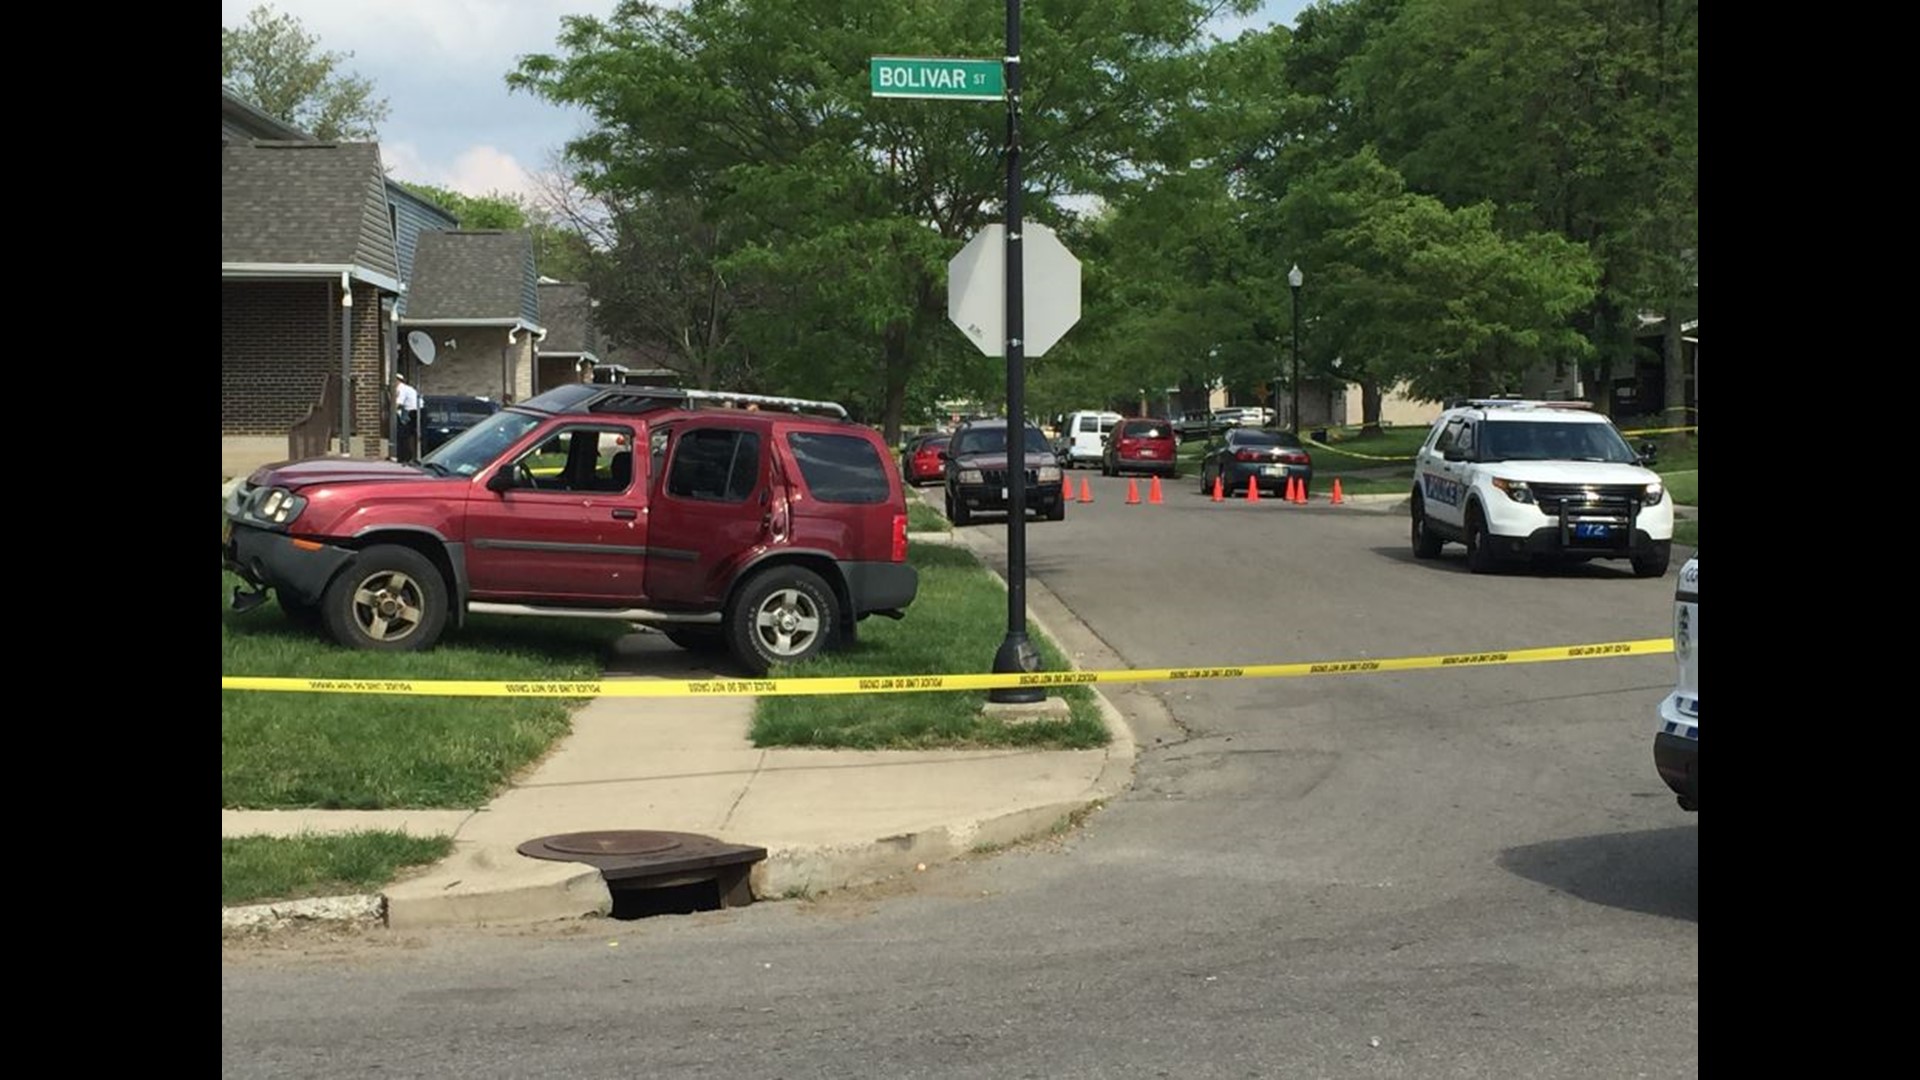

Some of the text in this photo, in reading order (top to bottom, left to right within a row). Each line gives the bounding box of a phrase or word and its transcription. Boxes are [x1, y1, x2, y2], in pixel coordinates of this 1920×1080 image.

[879, 66, 986, 89] BOLIVAR ST
[1427, 475, 1456, 504] POLICE
[1169, 671, 1188, 679] CROSS
[1188, 670, 1201, 678] NOT
[1210, 669, 1224, 678] LINE
[1224, 668, 1244, 677] POLICE
[859, 678, 943, 689] POLICE LINE DO NOT CROSS
[1019, 673, 1098, 685] POLICE LINE DO NOT CROSS
[505, 684, 601, 693] POLICE LINE DO NOT CROSS
[688, 682, 777, 693] POLICE LINE DO NOT CROSS
